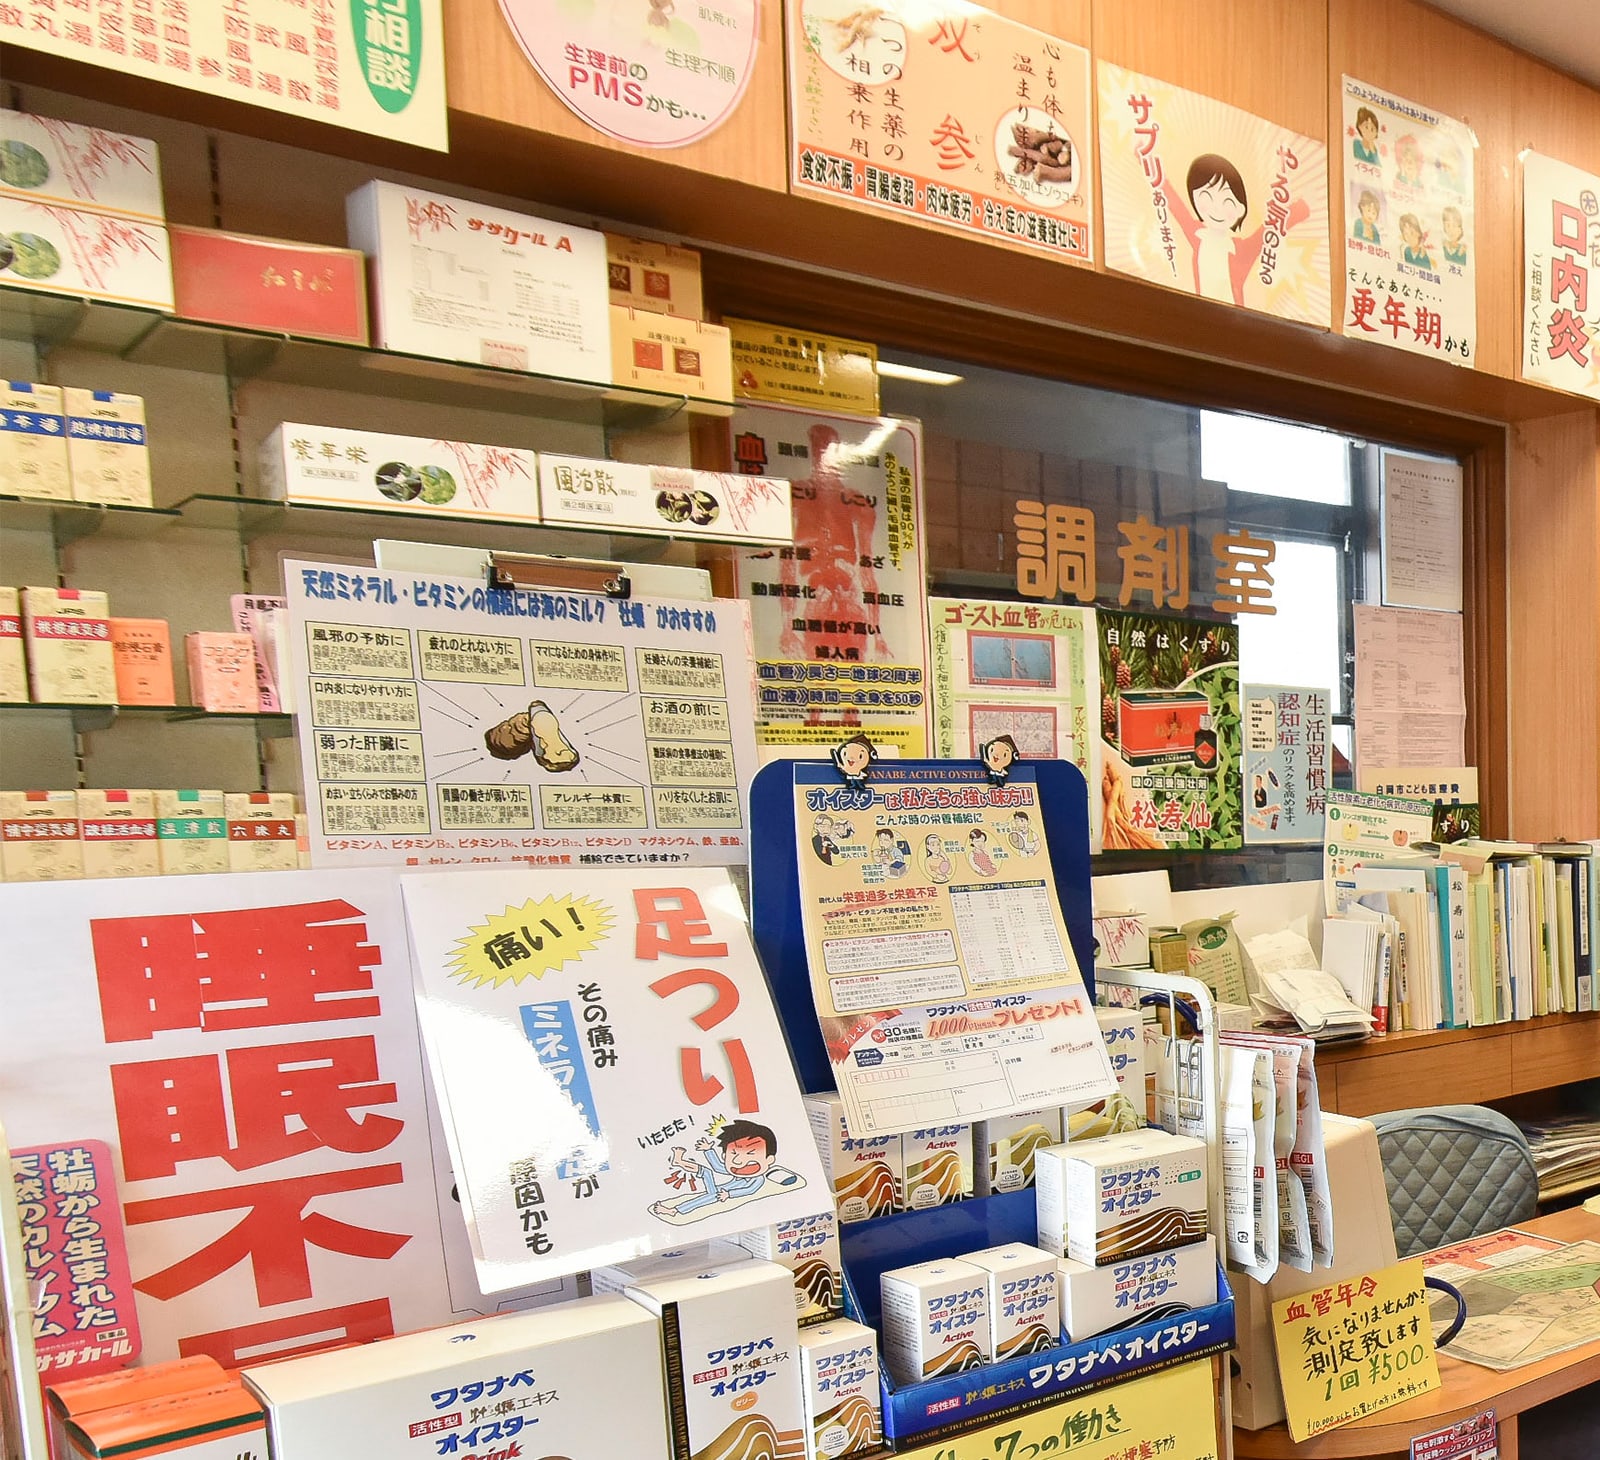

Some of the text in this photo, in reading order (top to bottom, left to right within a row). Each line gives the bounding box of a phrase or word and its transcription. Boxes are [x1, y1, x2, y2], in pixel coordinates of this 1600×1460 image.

[697, 7, 738, 30] 肌荒れ
[562, 41, 648, 83] 生理前の
[664, 48, 738, 85] 生理不順
[846, 52, 875, 159] 相乗作用
[1354, 162, 1382, 178] イライラ
[1258, 144, 1299, 287] やる気の出る
[554, 237, 573, 253] A
[1448, 264, 1463, 277] 冷え
[1547, 199, 1590, 369] 口内炎
[1530, 253, 1543, 367] ご相談ください
[290, 438, 369, 463] 紫華栄
[554, 465, 618, 496] 風治散
[840, 493, 878, 508] しこり
[1014, 500, 1276, 615] 調剤室
[751, 582, 816, 599] 動脈硬化
[863, 591, 904, 607] 高血圧
[792, 618, 881, 635] 血糖値が高い
[945, 603, 1084, 630] ゴースト血管が危ない
[312, 629, 405, 647] 風邪の予防に
[429, 636, 514, 655] 疲れのとれない方に
[1107, 628, 1231, 656] 自然はくすり
[535, 646, 621, 663] ママになるための身体作りに
[644, 652, 719, 669] 妊婦さんの栄養補給に
[314, 682, 413, 697] 口内炎になりやすい方に
[650, 701, 720, 716] お酒の前に
[321, 734, 409, 751] 弱った肝臓に
[1306, 694, 1326, 816] 生活習慣病
[910, 770, 988, 779] ACTIVE OYSTER
[442, 788, 526, 803] 胃腸の働きが弱い方に
[553, 793, 632, 804] アレルギー体質に
[658, 791, 732, 804] ハリをなくしたお肌に
[1376, 784, 1460, 795] 白岡市こども医療費
[875, 813, 984, 826] こんな時の栄養補給に
[1130, 800, 1212, 830] 松寿仙
[232, 825, 291, 836] 六味丸
[633, 887, 759, 1114] 足つり
[577, 982, 618, 1069] その痛み
[1101, 1165, 1161, 1190] ワタナベ
[1101, 1190, 1161, 1213] オイスター
[1119, 1207, 1140, 1217] Active
[1114, 1254, 1176, 1281] ワタナベ
[1002, 1271, 1055, 1293] ワタナベ
[928, 1288, 984, 1311] ワタナベ
[1003, 1294, 1056, 1317] オイスター
[1115, 1281, 1178, 1307] オイスター
[1133, 1300, 1156, 1311] Active
[1283, 1276, 1378, 1325] 血管年令
[929, 1311, 985, 1335] オイスター
[1015, 1312, 1045, 1326] Active
[942, 1329, 975, 1345] Active
[1303, 1315, 1421, 1380] 測定致します
[708, 1337, 774, 1365] ワタナベ
[816, 1345, 873, 1369] ワタナベ
[431, 1370, 536, 1409] ワタナベ
[710, 1371, 777, 1397] オイスター
[817, 1369, 874, 1392] オイスター
[834, 1386, 862, 1398] Active
[927, 1397, 960, 1415] 活性型
[436, 1416, 539, 1455] オイスター
